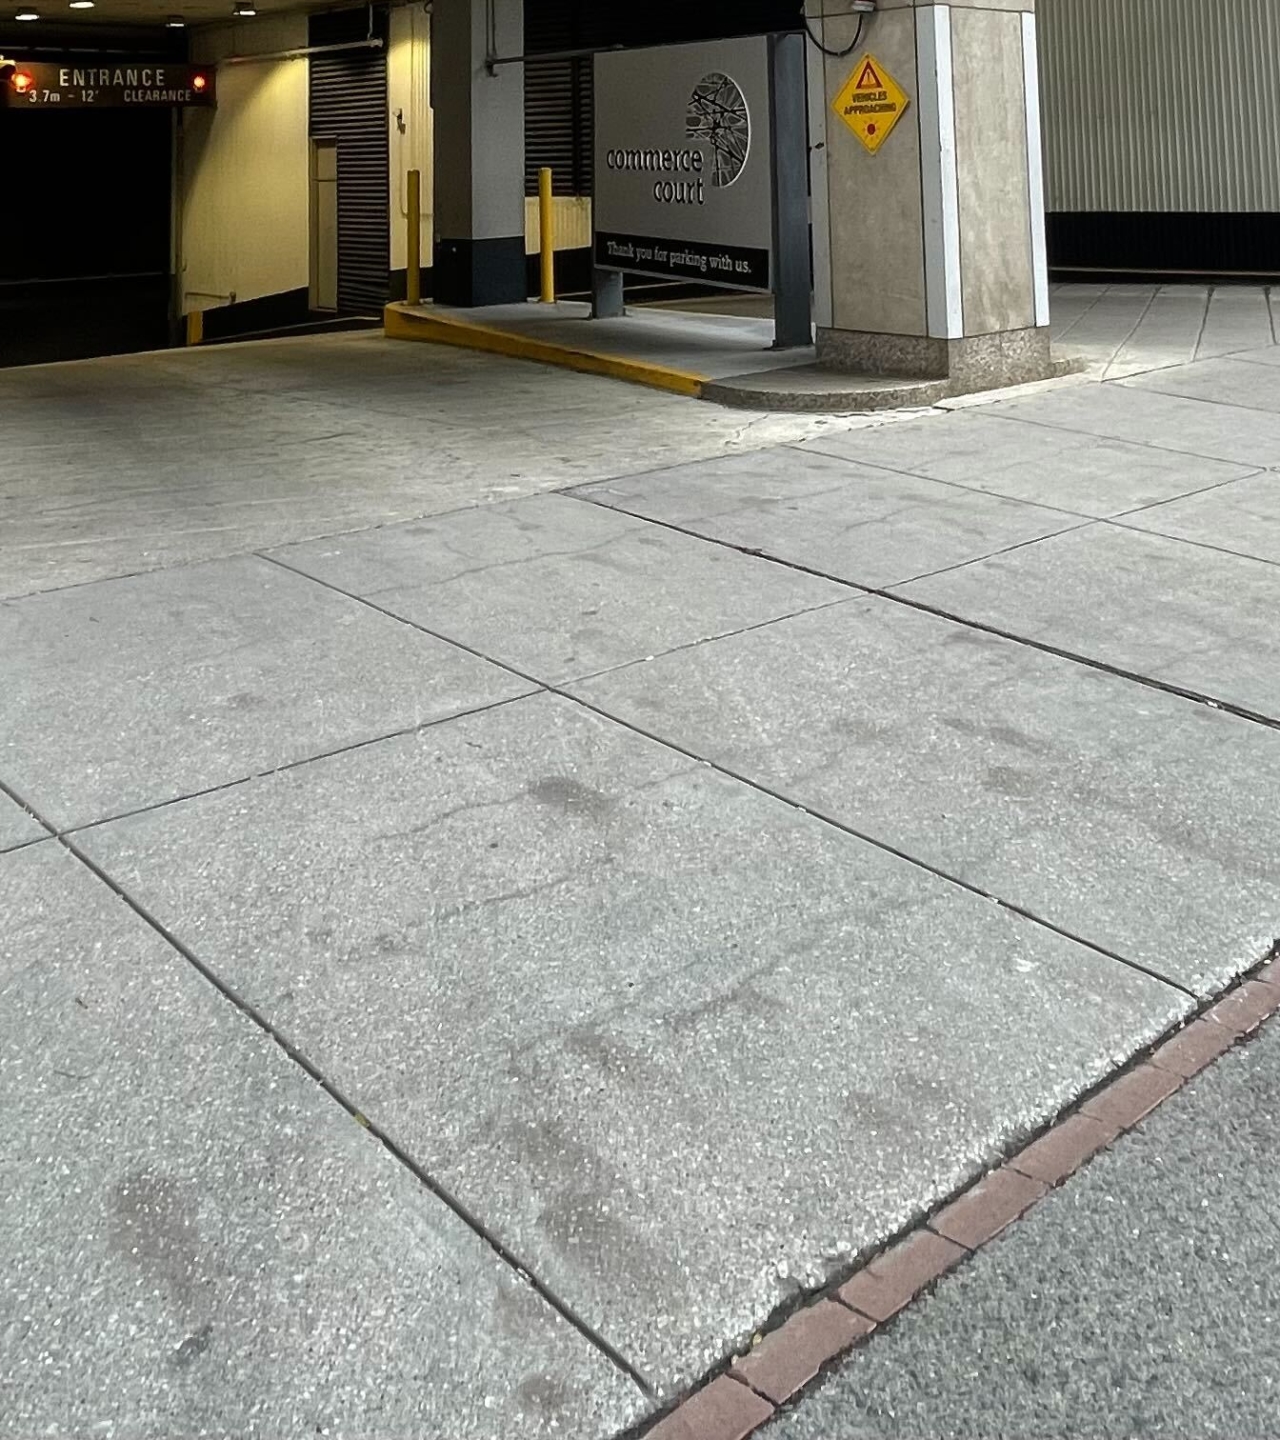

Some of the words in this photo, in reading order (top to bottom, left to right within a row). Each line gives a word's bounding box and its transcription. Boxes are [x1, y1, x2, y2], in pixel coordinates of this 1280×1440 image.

[59, 68, 166, 87] ENTRANCE
[28, 89, 61, 103] 3.7m
[81, 89, 100, 103] 12'
[124, 89, 191, 102] CLEARANCE
[852, 91, 887, 103] VEHICLES
[844, 103, 896, 115] APPROACHING
[607, 149, 704, 172] commerce
[653, 177, 706, 205] court
[607, 241, 635, 259] Thank
[636, 247, 653, 263] you
[654, 245, 669, 262] for
[670, 249, 708, 273] parking
[709, 254, 734, 273] with
[735, 262, 753, 274] us.
